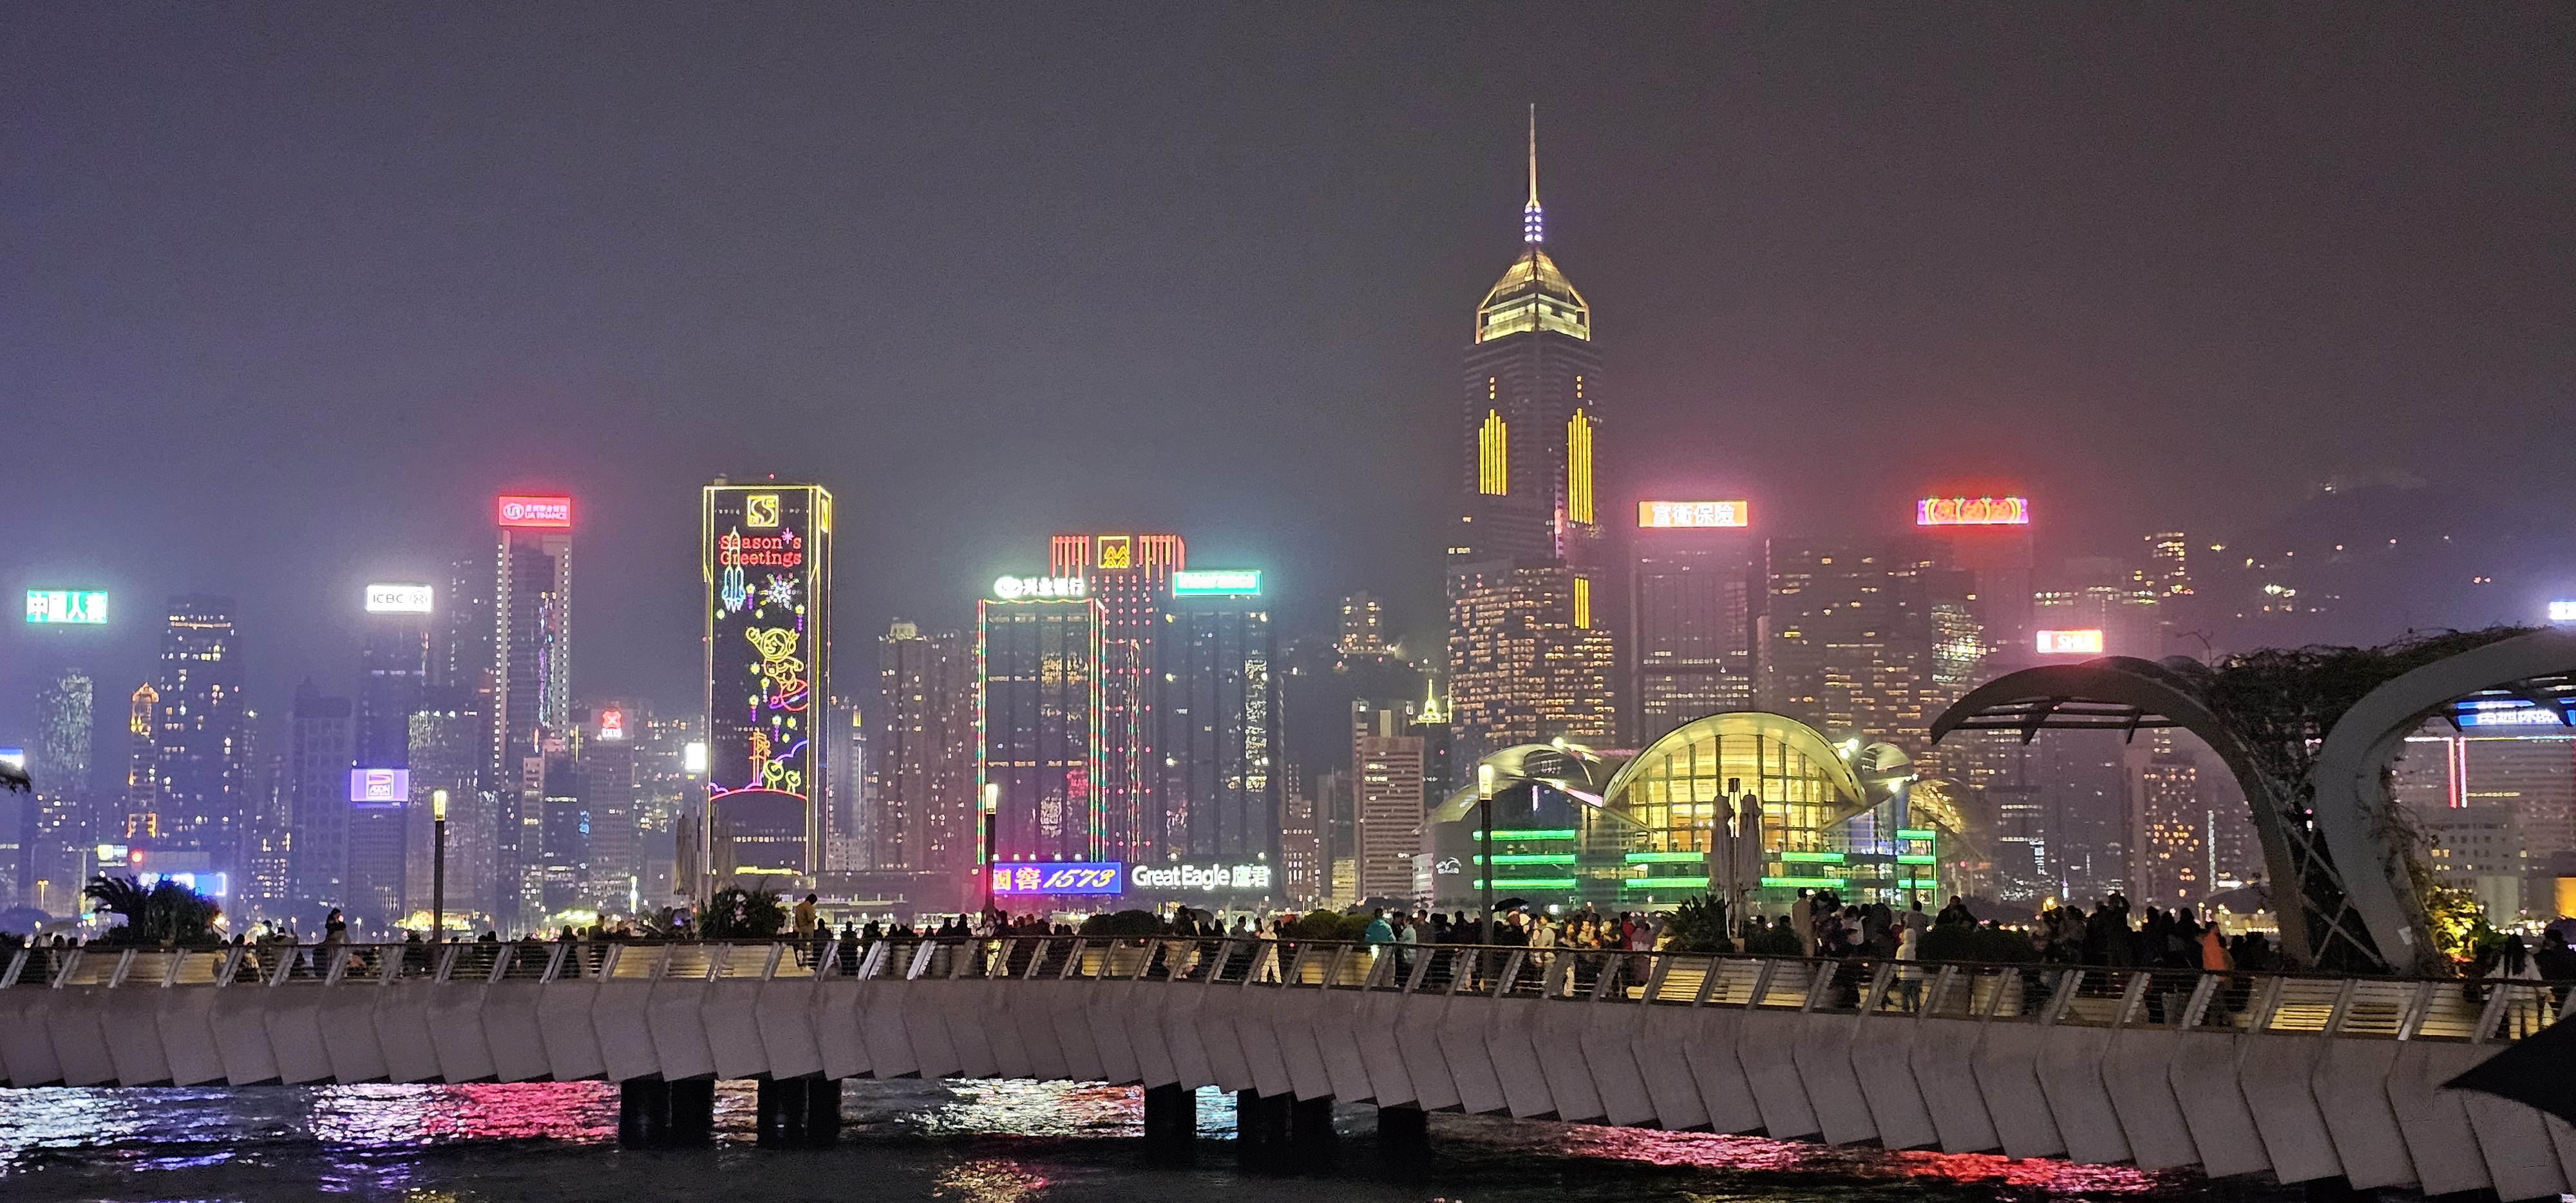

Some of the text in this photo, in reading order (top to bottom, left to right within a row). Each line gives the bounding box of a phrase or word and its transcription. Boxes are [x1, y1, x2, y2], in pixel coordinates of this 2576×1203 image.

[1652, 504, 1736, 526] 富衛保險
[720, 551, 802, 568] Greetings
[374, 594, 403, 603] ICBC
[1043, 869, 1115, 888] 1573
[1132, 865, 1181, 886] Great
[1182, 864, 1230, 890] Eagle
